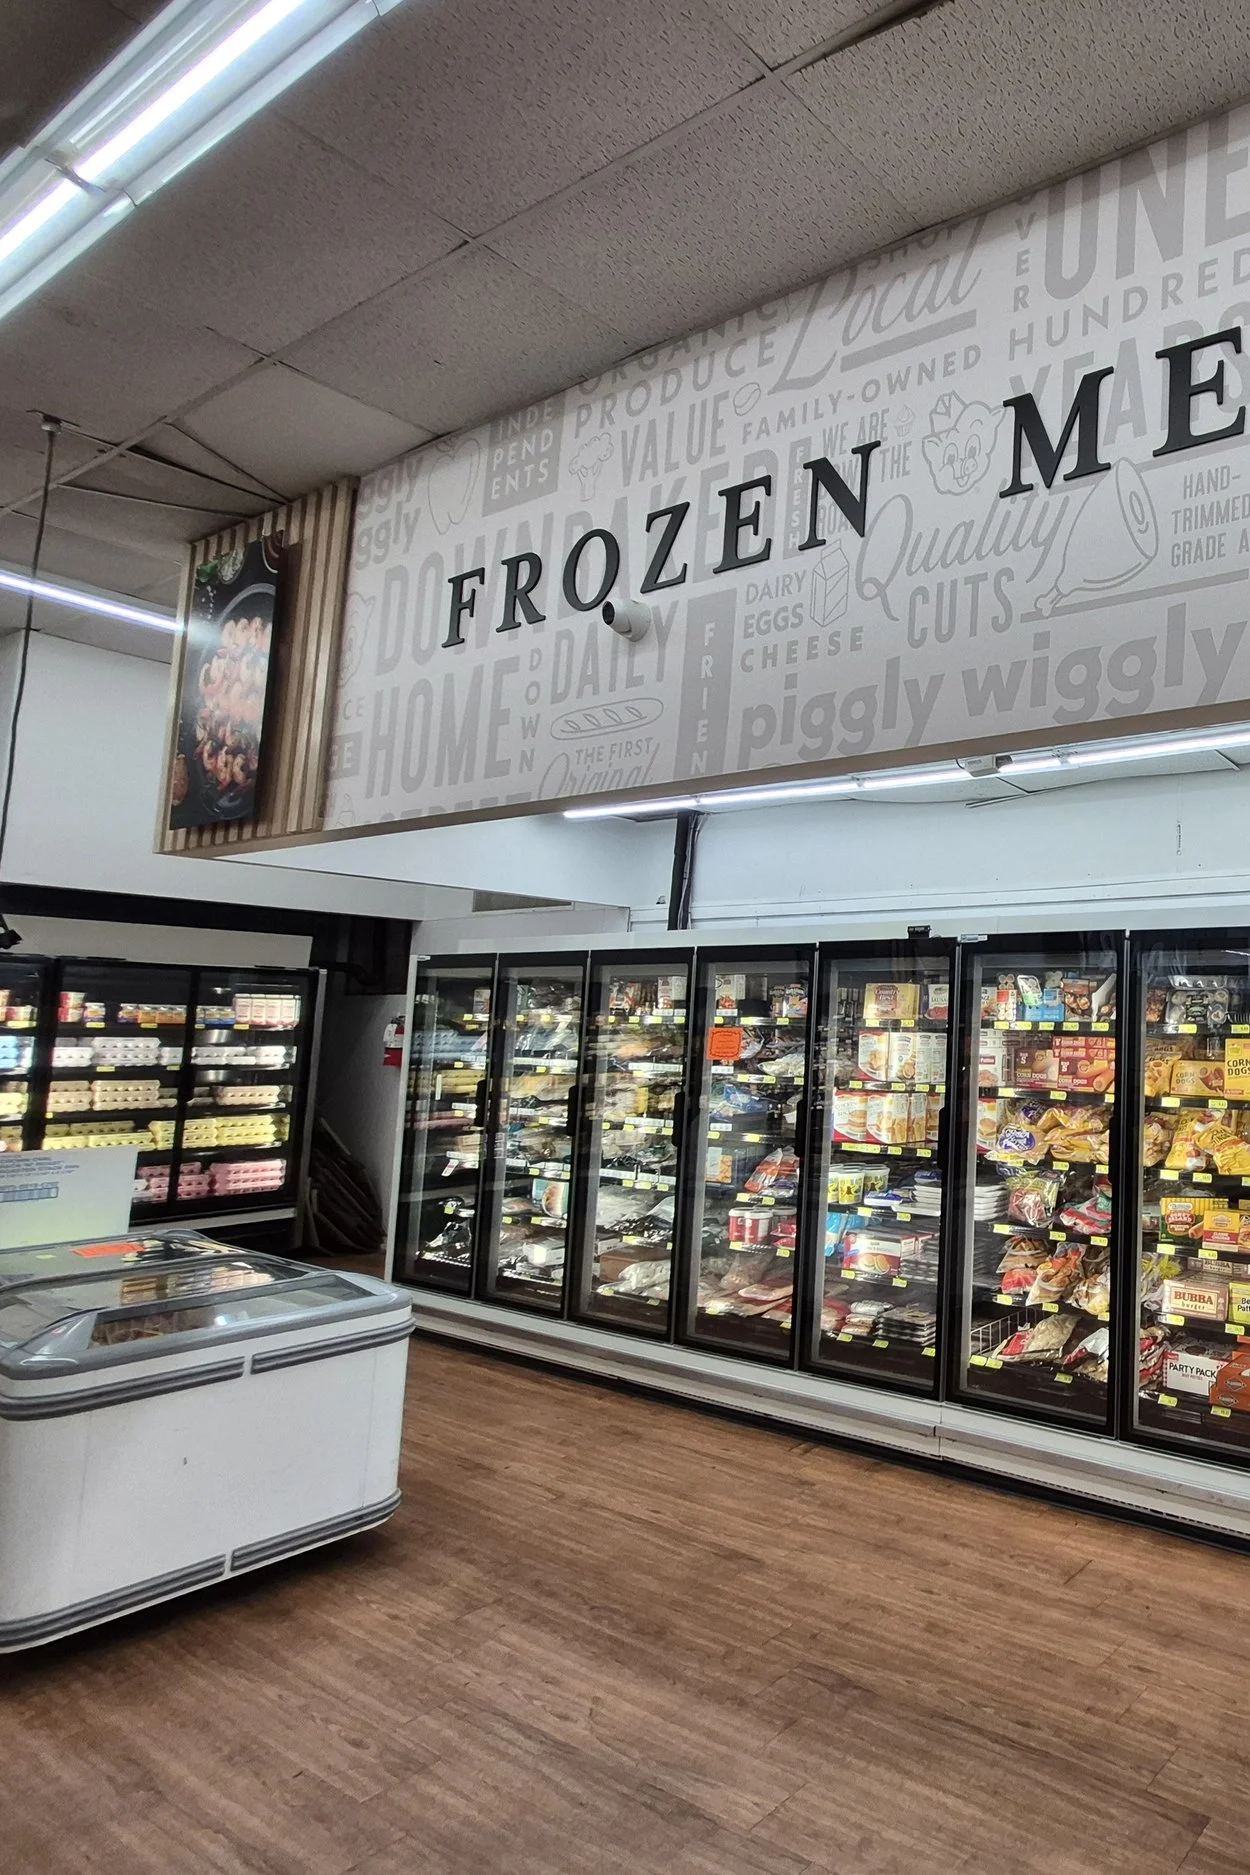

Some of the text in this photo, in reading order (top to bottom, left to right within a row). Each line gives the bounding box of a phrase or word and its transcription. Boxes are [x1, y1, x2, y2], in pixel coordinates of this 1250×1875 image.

[767, 212, 984, 395] Local
[574, 324, 779, 440] PRODUCE
[741, 344, 982, 446] FAMILY-OWNED
[491, 429, 554, 473] PEND
[620, 389, 731, 488] VALUE
[823, 407, 891, 458] WE ARE
[490, 458, 549, 501] ENTS
[879, 440, 913, 482] THE
[1183, 465, 1241, 500] HAND-
[816, 502, 853, 541] ROA
[442, 439, 881, 649] FROZEN
[854, 478, 1070, 622] Quality
[1171, 529, 1250, 569] GRADE A
[746, 569, 807, 606] DAIRY
[907, 567, 1015, 648] CUTS
[743, 602, 804, 639] EGGS
[549, 597, 678, 707] DAILY
[739, 626, 864, 673] CHEESE
[736, 601, 1249, 771] piggly wiggly
[364, 655, 520, 800] HOME
[518, 647, 544, 774] DOWN
[575, 737, 655, 767] THE FIRST
[1175, 1071, 1195, 1080] CORN
[1175, 1077, 1195, 1086] DOGS
[1203, 1259, 1231, 1270] BUBBA
[1173, 1289, 1214, 1306] BUBBA
[1181, 1302, 1206, 1312] burger
[1168, 1361, 1217, 1379] PARTY PACK
